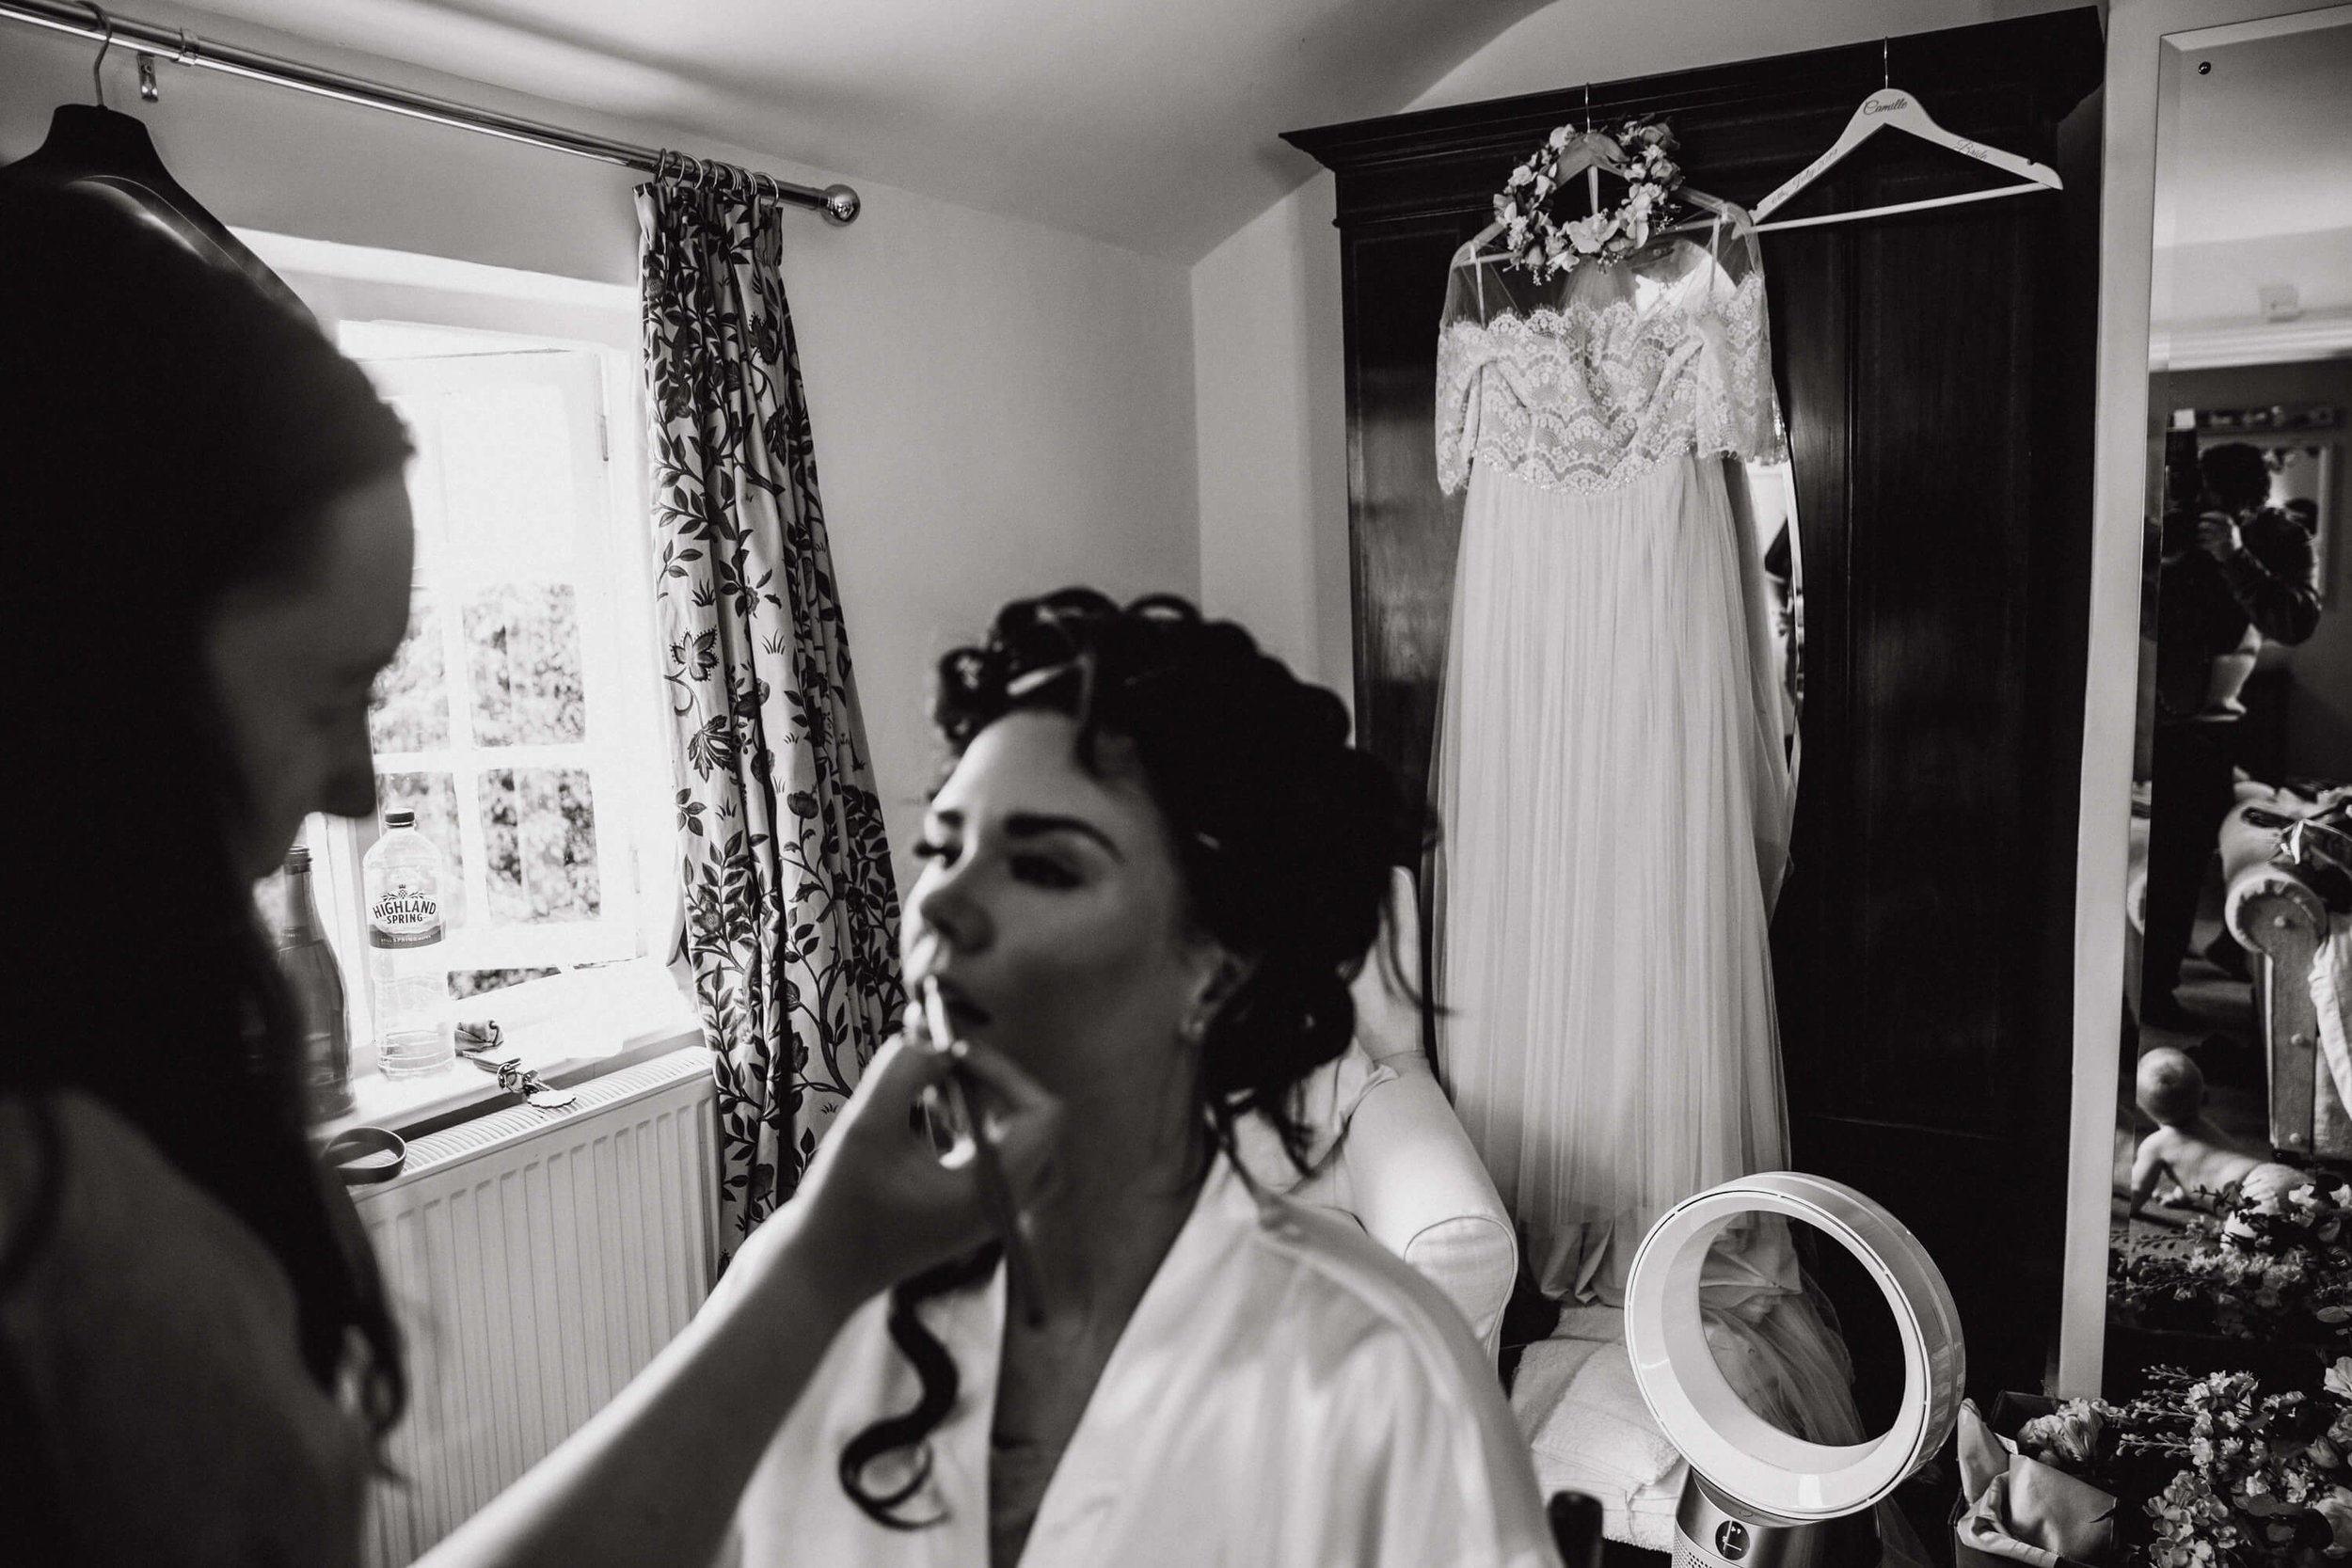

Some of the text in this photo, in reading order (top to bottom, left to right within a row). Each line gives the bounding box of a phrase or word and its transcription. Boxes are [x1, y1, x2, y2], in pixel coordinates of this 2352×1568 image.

[1863, 98, 1908, 115] Camille
[373, 900, 437, 919] HIGHLAND
[387, 913, 423, 924] SPRING
